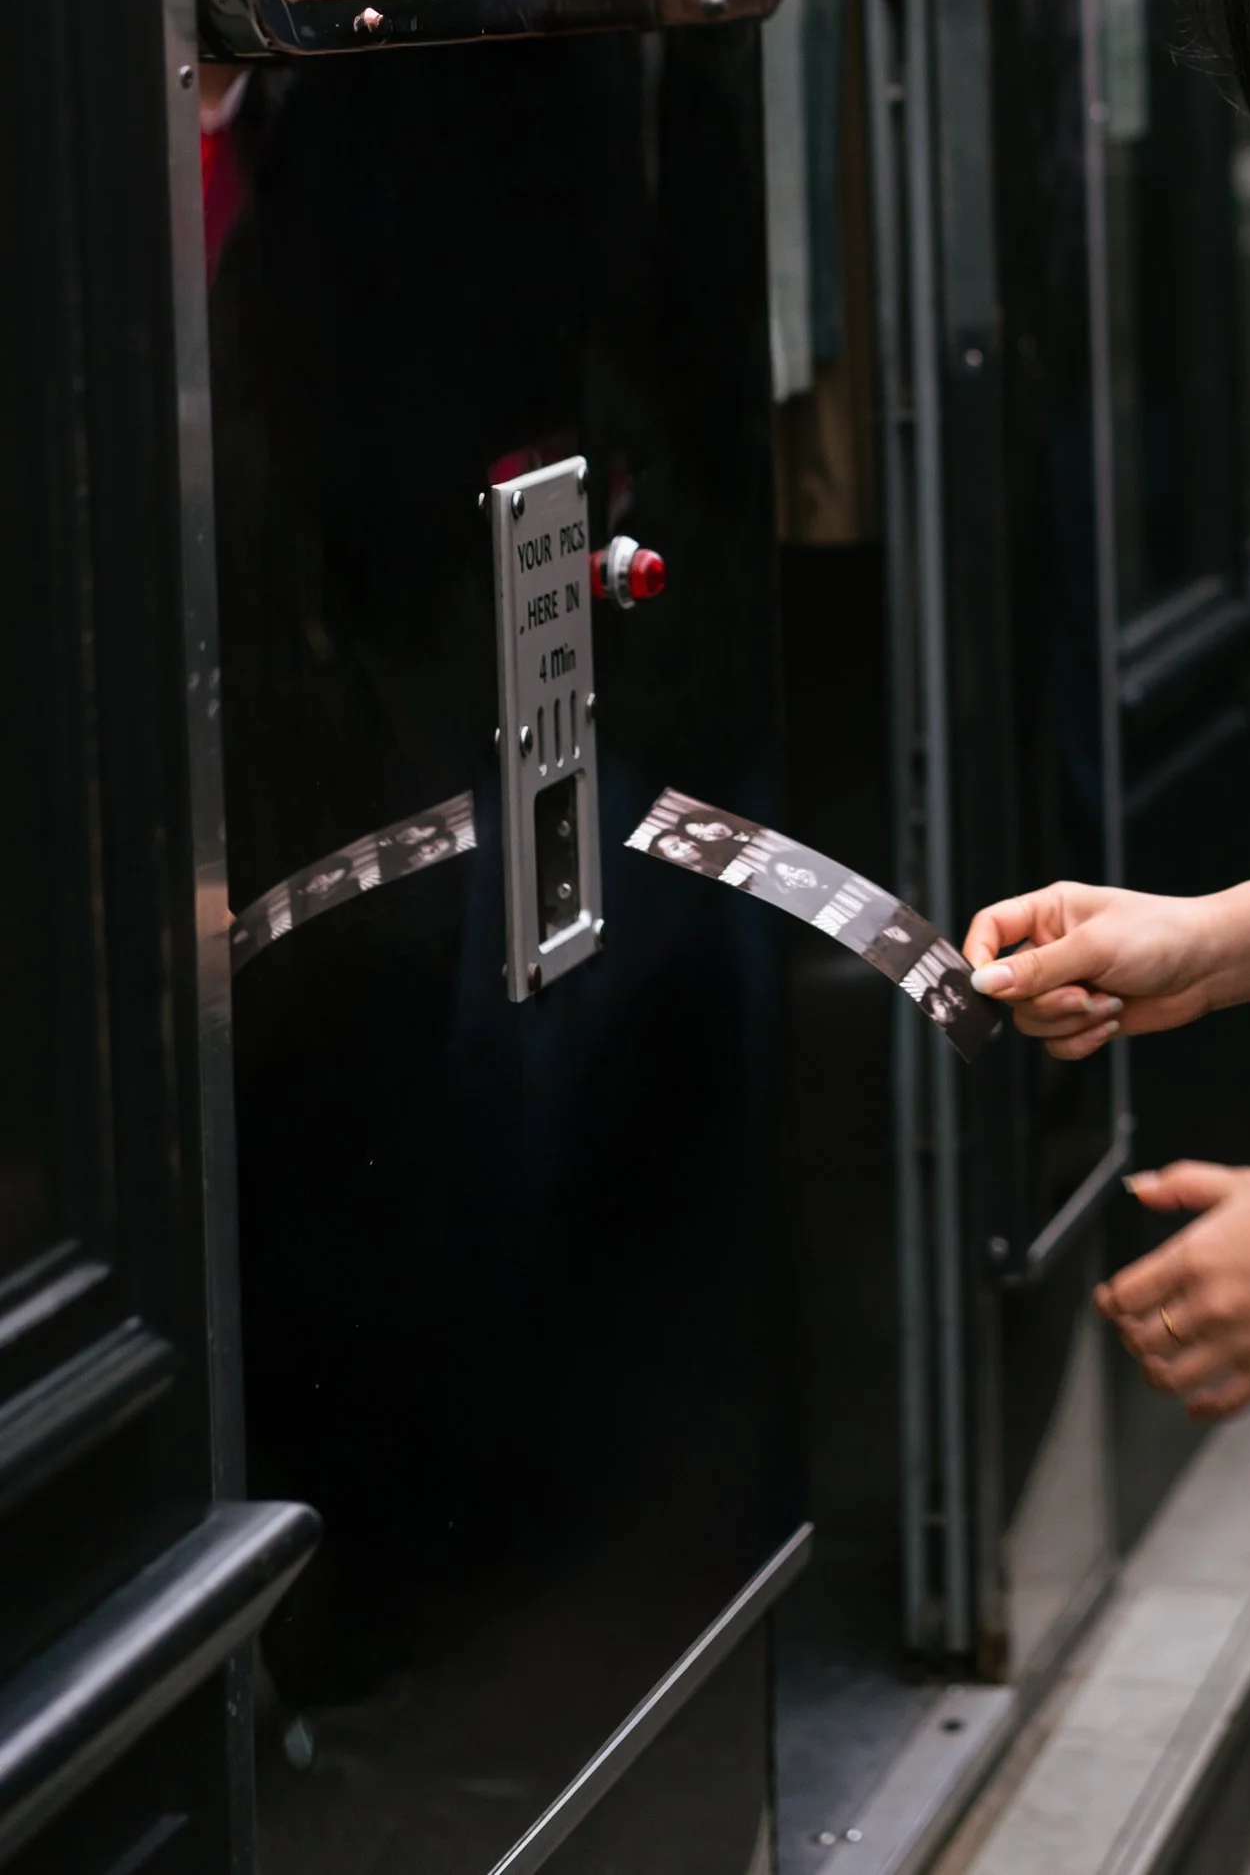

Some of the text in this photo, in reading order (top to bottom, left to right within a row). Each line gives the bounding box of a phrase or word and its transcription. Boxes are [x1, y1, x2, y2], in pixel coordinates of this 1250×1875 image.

[517, 520, 586, 573] YOUR PICS
[527, 581, 580, 630] HERE IN
[539, 643, 577, 684] 4 min
